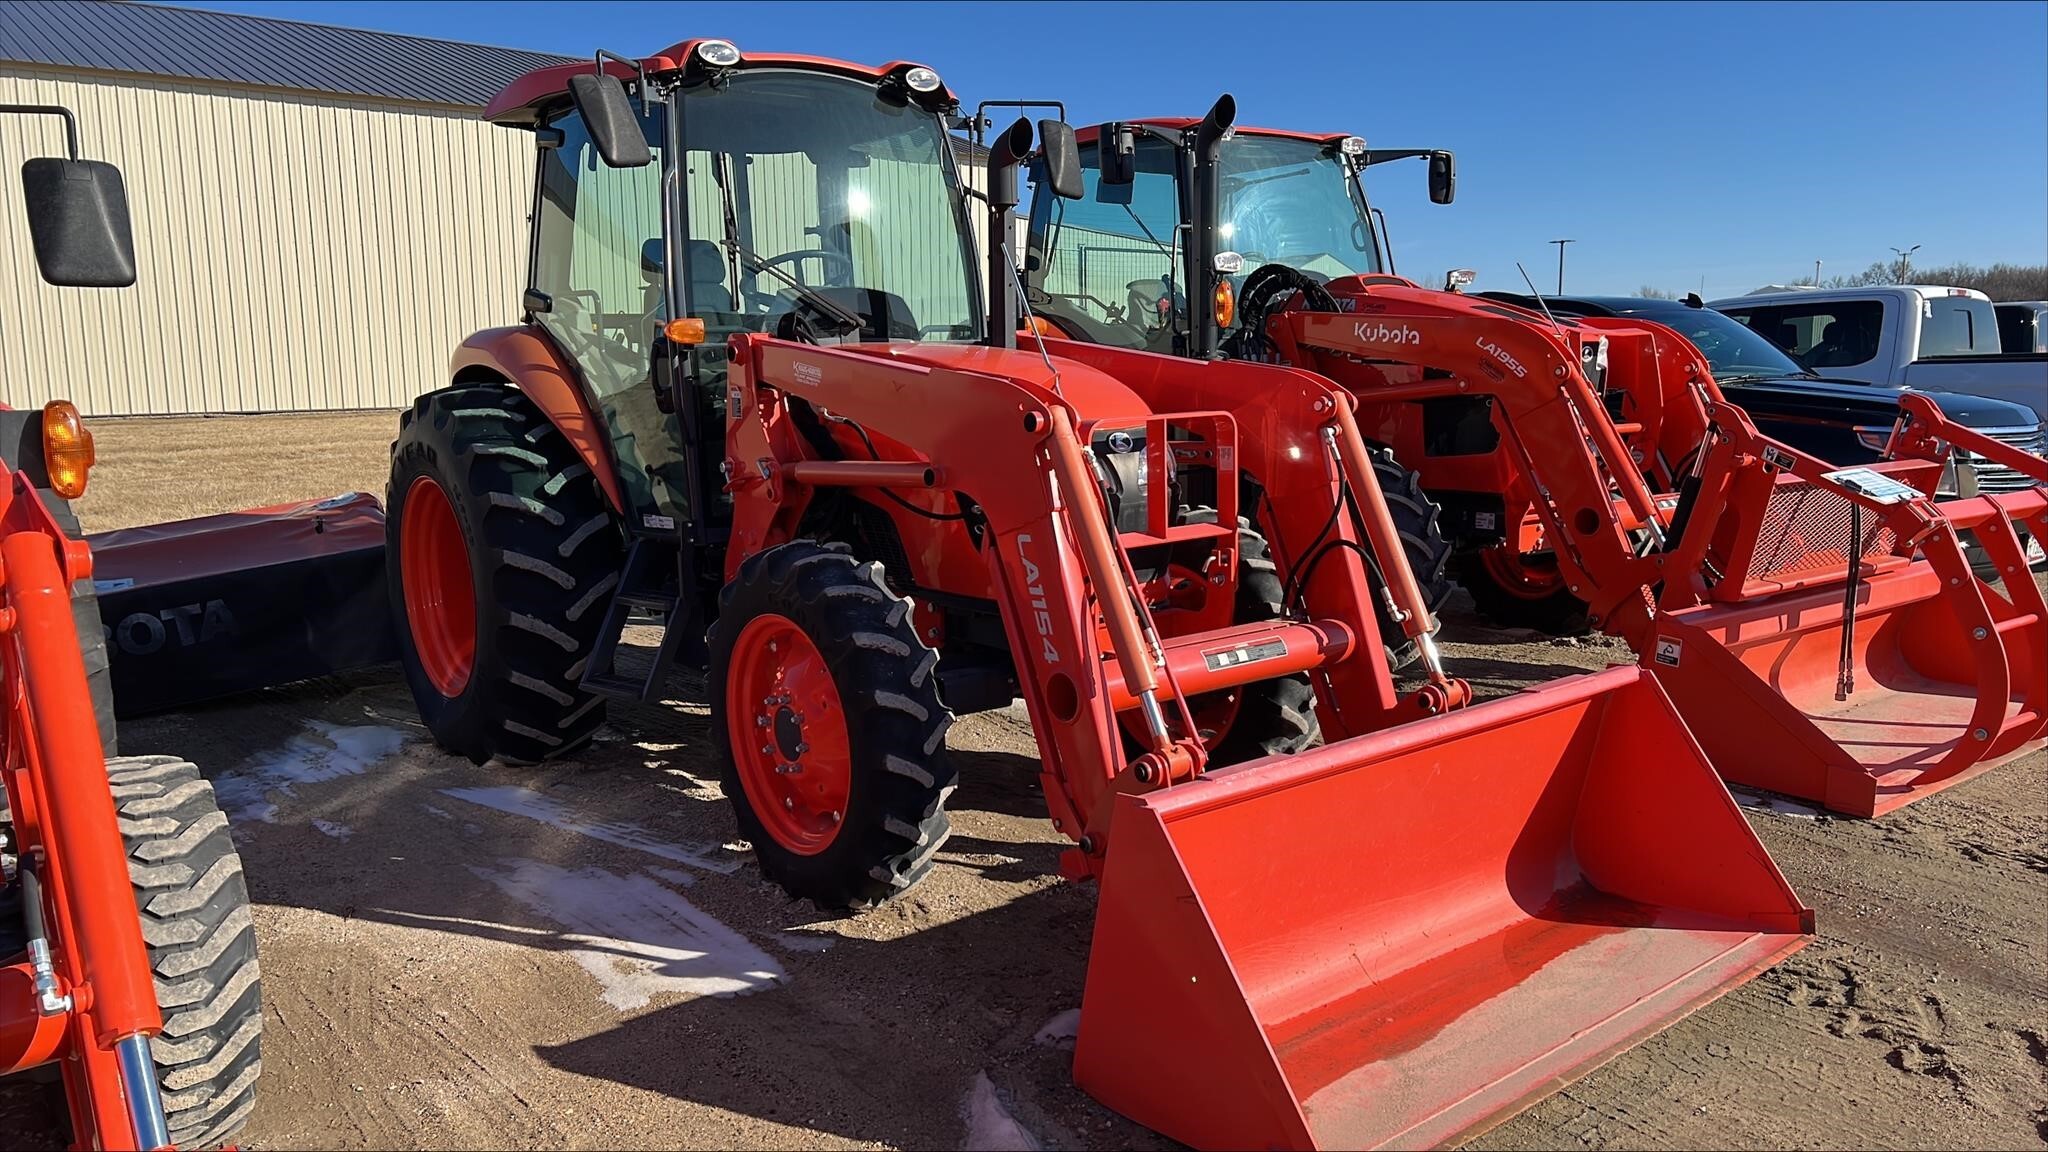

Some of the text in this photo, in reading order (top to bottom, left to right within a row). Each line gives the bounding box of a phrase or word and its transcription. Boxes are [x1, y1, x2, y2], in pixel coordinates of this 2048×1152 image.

[1354, 322, 1420, 345] Kubota
[1475, 336, 1528, 378] LA1955
[1017, 534, 1060, 664] LA1154
